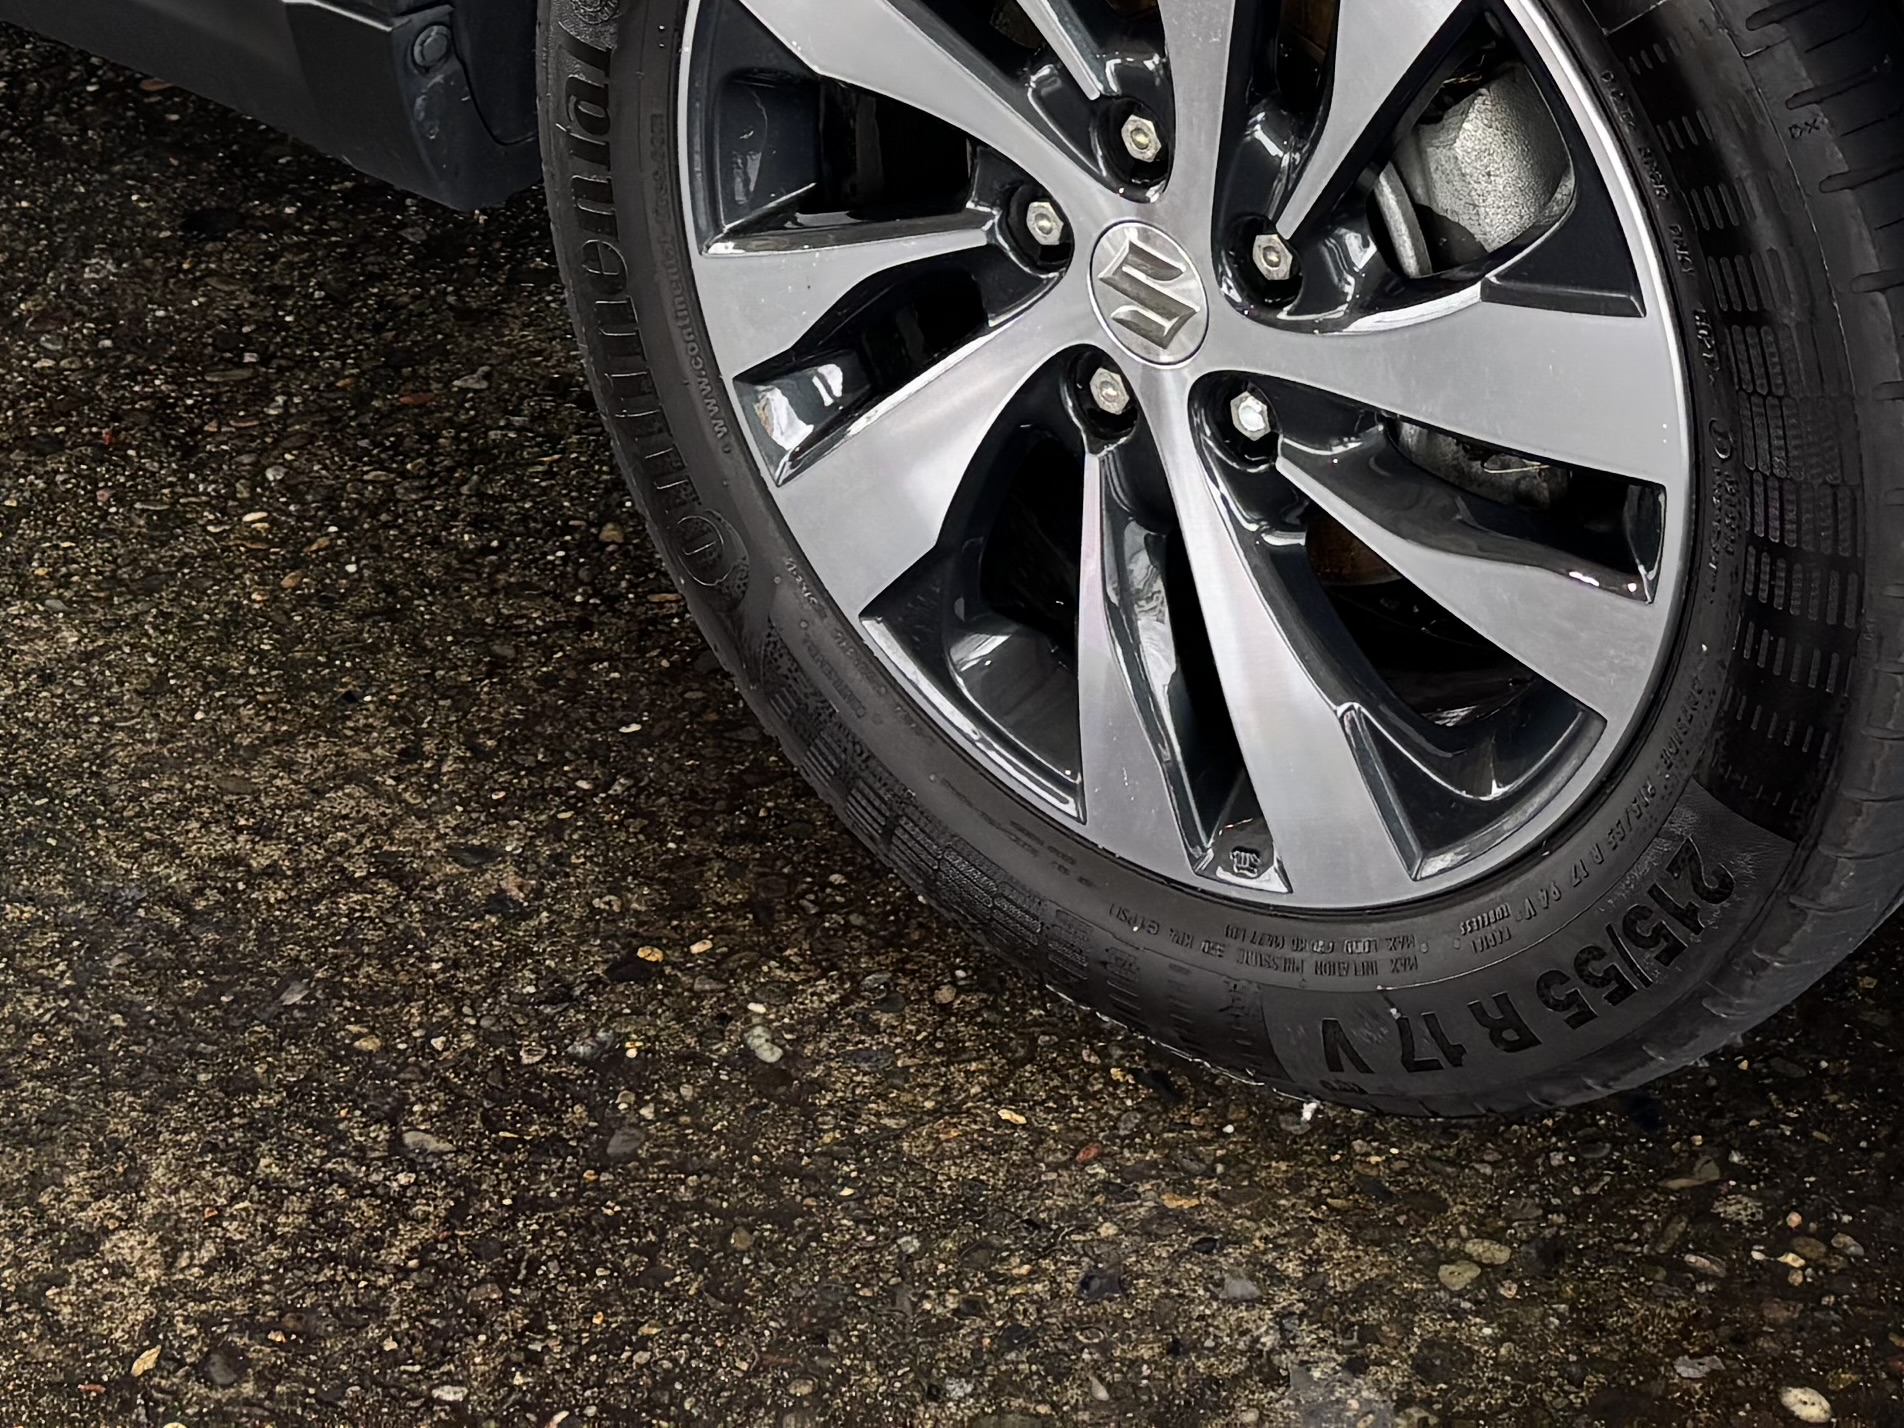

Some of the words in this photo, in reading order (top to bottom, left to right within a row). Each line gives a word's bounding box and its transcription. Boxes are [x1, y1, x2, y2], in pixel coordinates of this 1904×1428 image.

[1535, 836, 1735, 1030] 215/55
[1321, 1018, 1375, 1074] V
[1396, 1012, 1468, 1074] 17
[1467, 992, 1543, 1053] R
